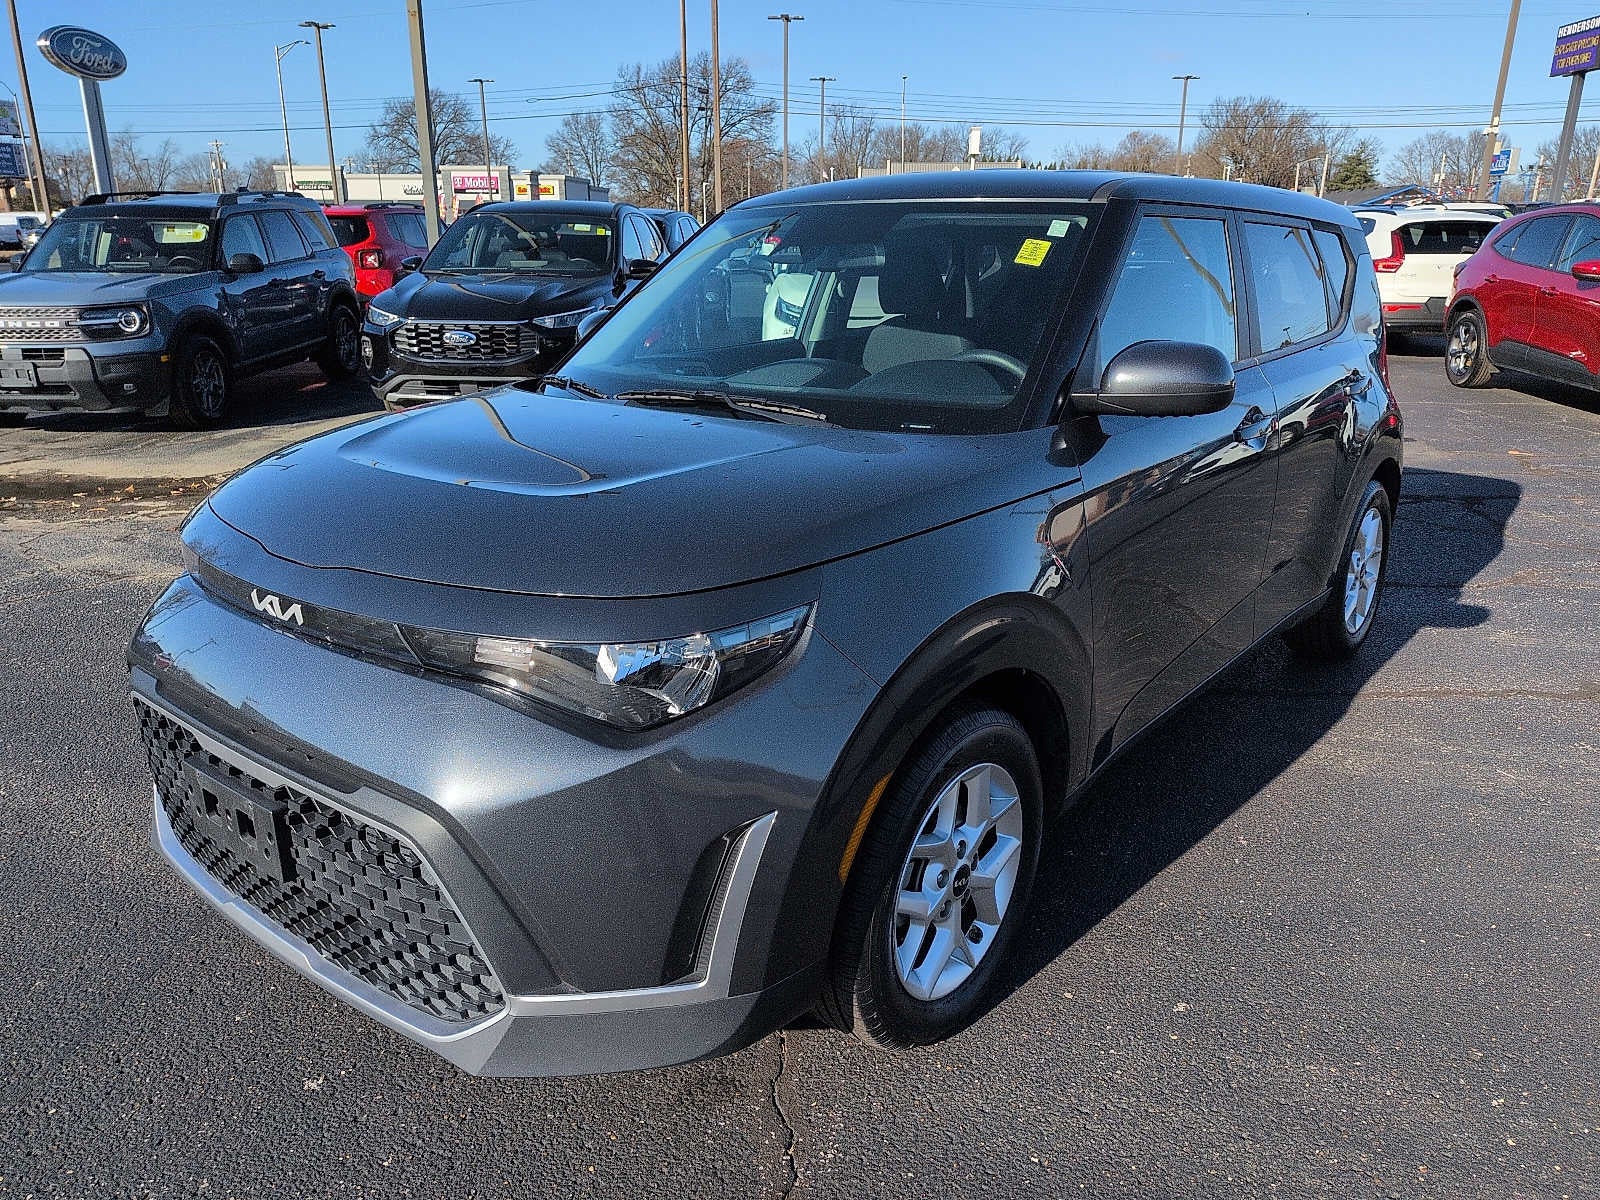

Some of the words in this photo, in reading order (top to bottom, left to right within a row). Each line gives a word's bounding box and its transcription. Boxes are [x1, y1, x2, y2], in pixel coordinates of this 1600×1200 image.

[70, 36, 115, 71] Ford
[465, 177, 496, 187] Mobie
[251, 588, 304, 625] KIA
